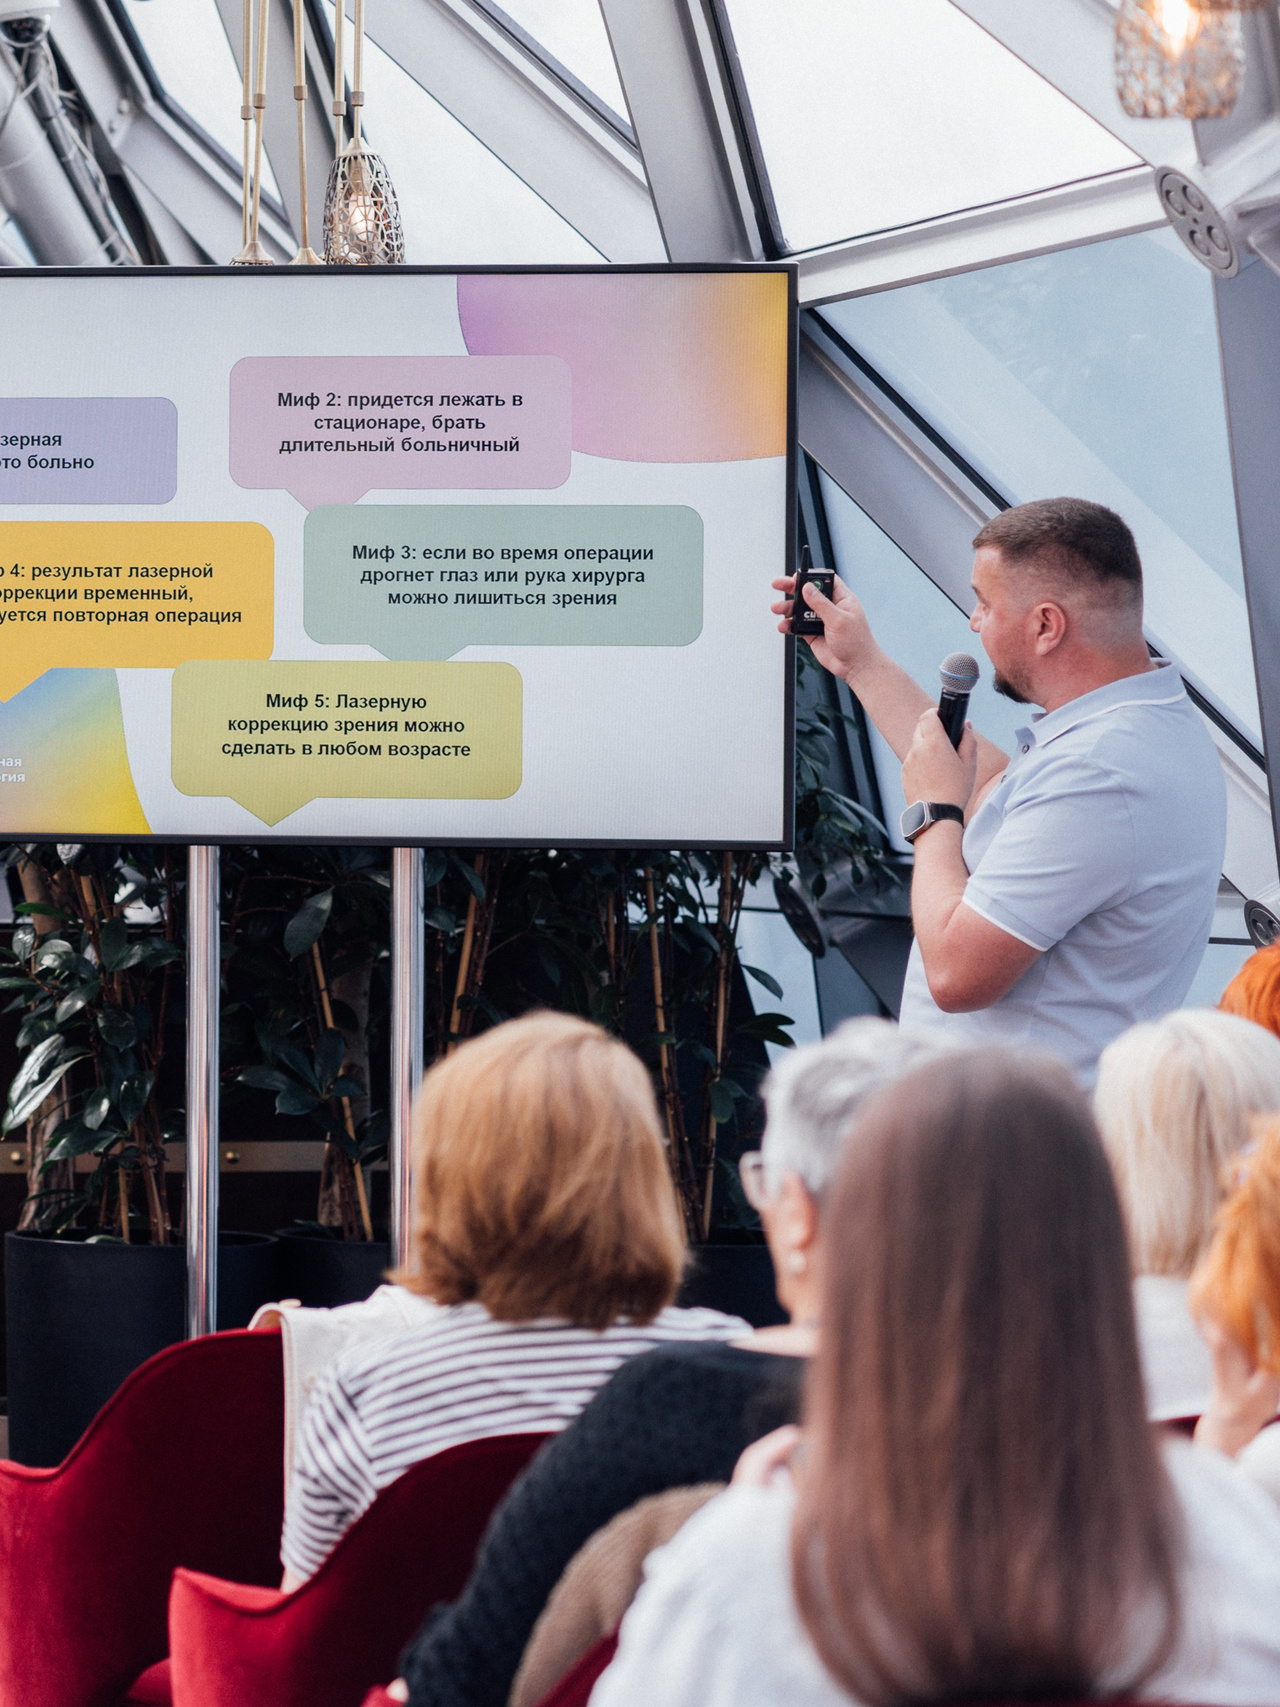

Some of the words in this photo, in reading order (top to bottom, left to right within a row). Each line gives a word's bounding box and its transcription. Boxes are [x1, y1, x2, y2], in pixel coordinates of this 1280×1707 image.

[277, 392, 321, 410] Миф
[325, 392, 342, 406] 2:
[348, 395, 434, 410] придется
[438, 394, 506, 406] лежать
[512, 394, 523, 406] в
[313, 418, 426, 432] стационаре,
[431, 414, 486, 432] брать
[278, 436, 395, 454] длительный
[401, 436, 520, 451] больничный
[27, 454, 95, 468] больно
[352, 544, 395, 562] Миф
[400, 545, 417, 559] 3:
[422, 548, 467, 559] если
[472, 548, 495, 559] во
[500, 548, 558, 563] время
[563, 548, 654, 563] операции
[9, 563, 26, 578] 4:
[31, 566, 123, 580] результат
[127, 563, 213, 580] лазерной
[360, 570, 435, 585] дрогнет
[440, 570, 479, 581] глаз
[484, 570, 518, 582] или
[524, 570, 566, 585] рука
[571, 571, 645, 586] хирурга
[83, 585, 193, 603] временный,
[388, 592, 449, 604] можно
[453, 593, 546, 604] лишиться
[551, 593, 617, 608] зрения
[53, 610, 149, 625] повторная
[154, 611, 242, 625] операция
[266, 693, 309, 711] Миф
[314, 693, 330, 707] 5:
[335, 693, 427, 712] Лазерную
[228, 719, 329, 734] коррекцию
[334, 720, 399, 735] зрения
[404, 720, 465, 732] можно
[221, 743, 296, 756] сделать
[302, 743, 313, 755] в
[317, 740, 382, 755] любом
[388, 744, 471, 759] возрасте
